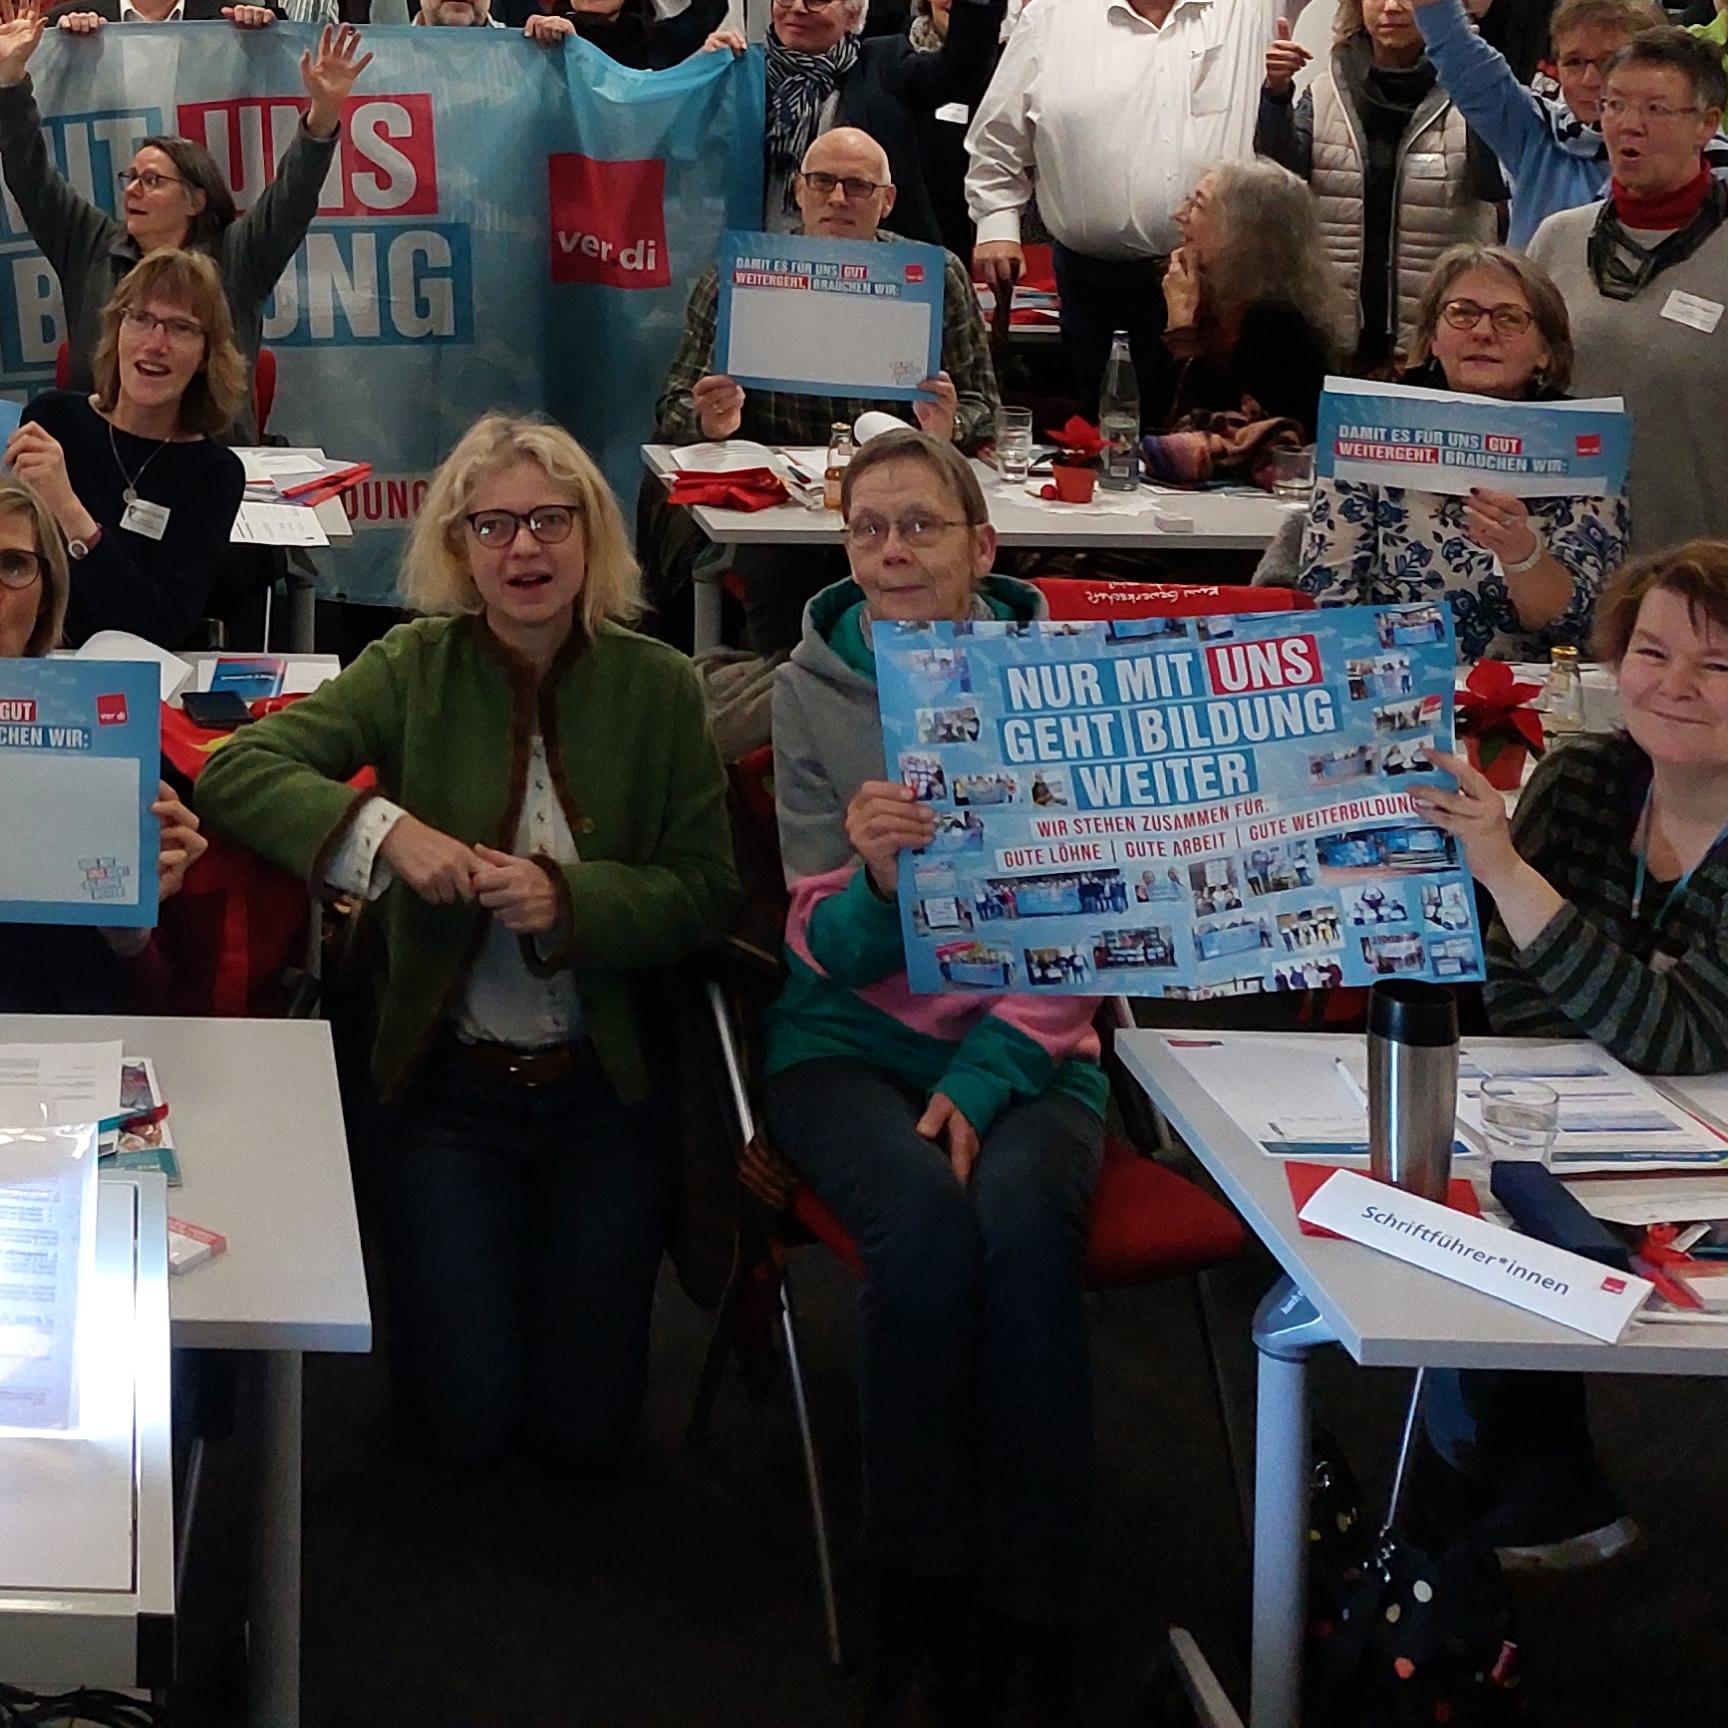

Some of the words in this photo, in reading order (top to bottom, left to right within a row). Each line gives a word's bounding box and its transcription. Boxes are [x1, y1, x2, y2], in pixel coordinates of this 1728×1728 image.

[736, 272, 805, 288] WEITERGEHT,
[874, 284, 900, 296] WIR:
[774, 261, 787, 271] ES
[844, 266, 865, 278] GUT
[1339, 425, 1386, 441] DAMIT
[1392, 429, 1410, 442] ES
[1448, 433, 1479, 448] UNS
[1488, 439, 1518, 453] GUT
[1339, 442, 1436, 462] WEITERGEHT,
[1445, 451, 1526, 472] BRAUCHEN
[1532, 458, 1568, 472] WIR:
[1007, 663, 1103, 710] NUR
[1116, 653, 1196, 702] MIT
[1217, 638, 1316, 692] UNS
[0, 702, 32, 720] GUT
[1003, 714, 1116, 763] GEHT
[1136, 689, 1337, 754] BILDUNG
[49, 729, 89, 748] WIR:
[1079, 752, 1251, 809] WEITER
[1037, 822, 1069, 838] WIR
[1074, 816, 1137, 835] STEHEN
[1142, 806, 1230, 832] ZUSAMMEN
[1004, 849, 1044, 868] GUTE
[1048, 842, 1102, 863] LÖHNE
[1125, 840, 1167, 858] GUTE
[1173, 832, 1227, 857] ARBEIT
[1249, 820, 1288, 841] GUTE
